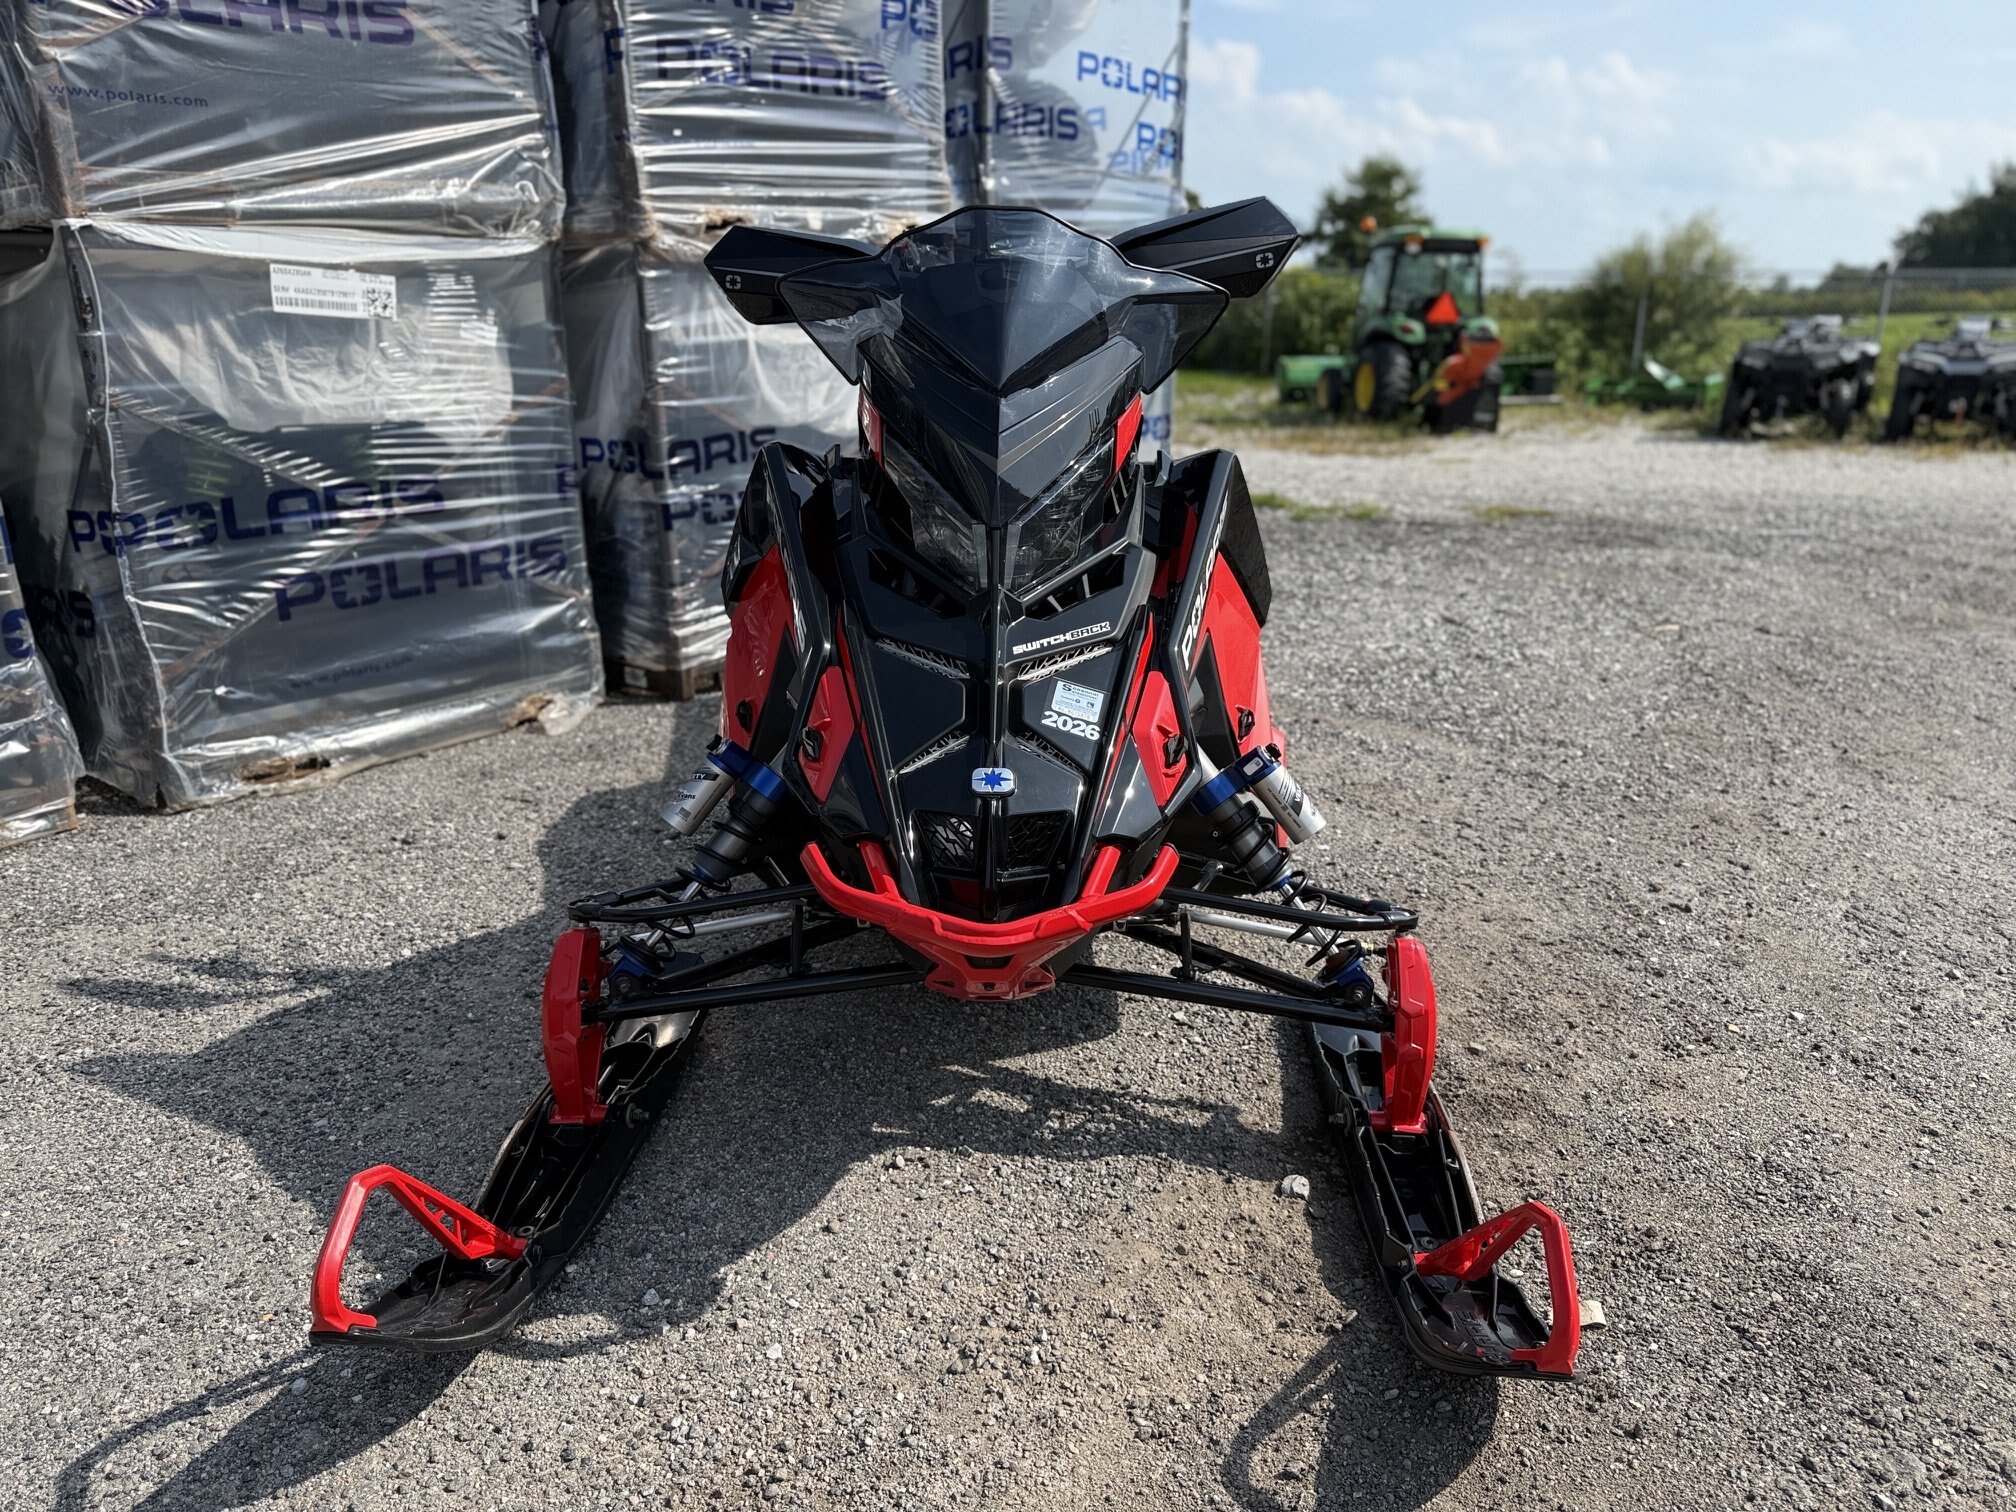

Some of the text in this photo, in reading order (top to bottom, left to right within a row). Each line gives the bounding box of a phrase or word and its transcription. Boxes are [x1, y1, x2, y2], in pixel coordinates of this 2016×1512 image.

[655, 38, 889, 101] POLARIS
[48, 81, 210, 108] www.polaris.com
[275, 536, 568, 622] POLARIS
[1012, 621, 1111, 655] SWITCHBACK
[1041, 710, 1101, 741] 2026
